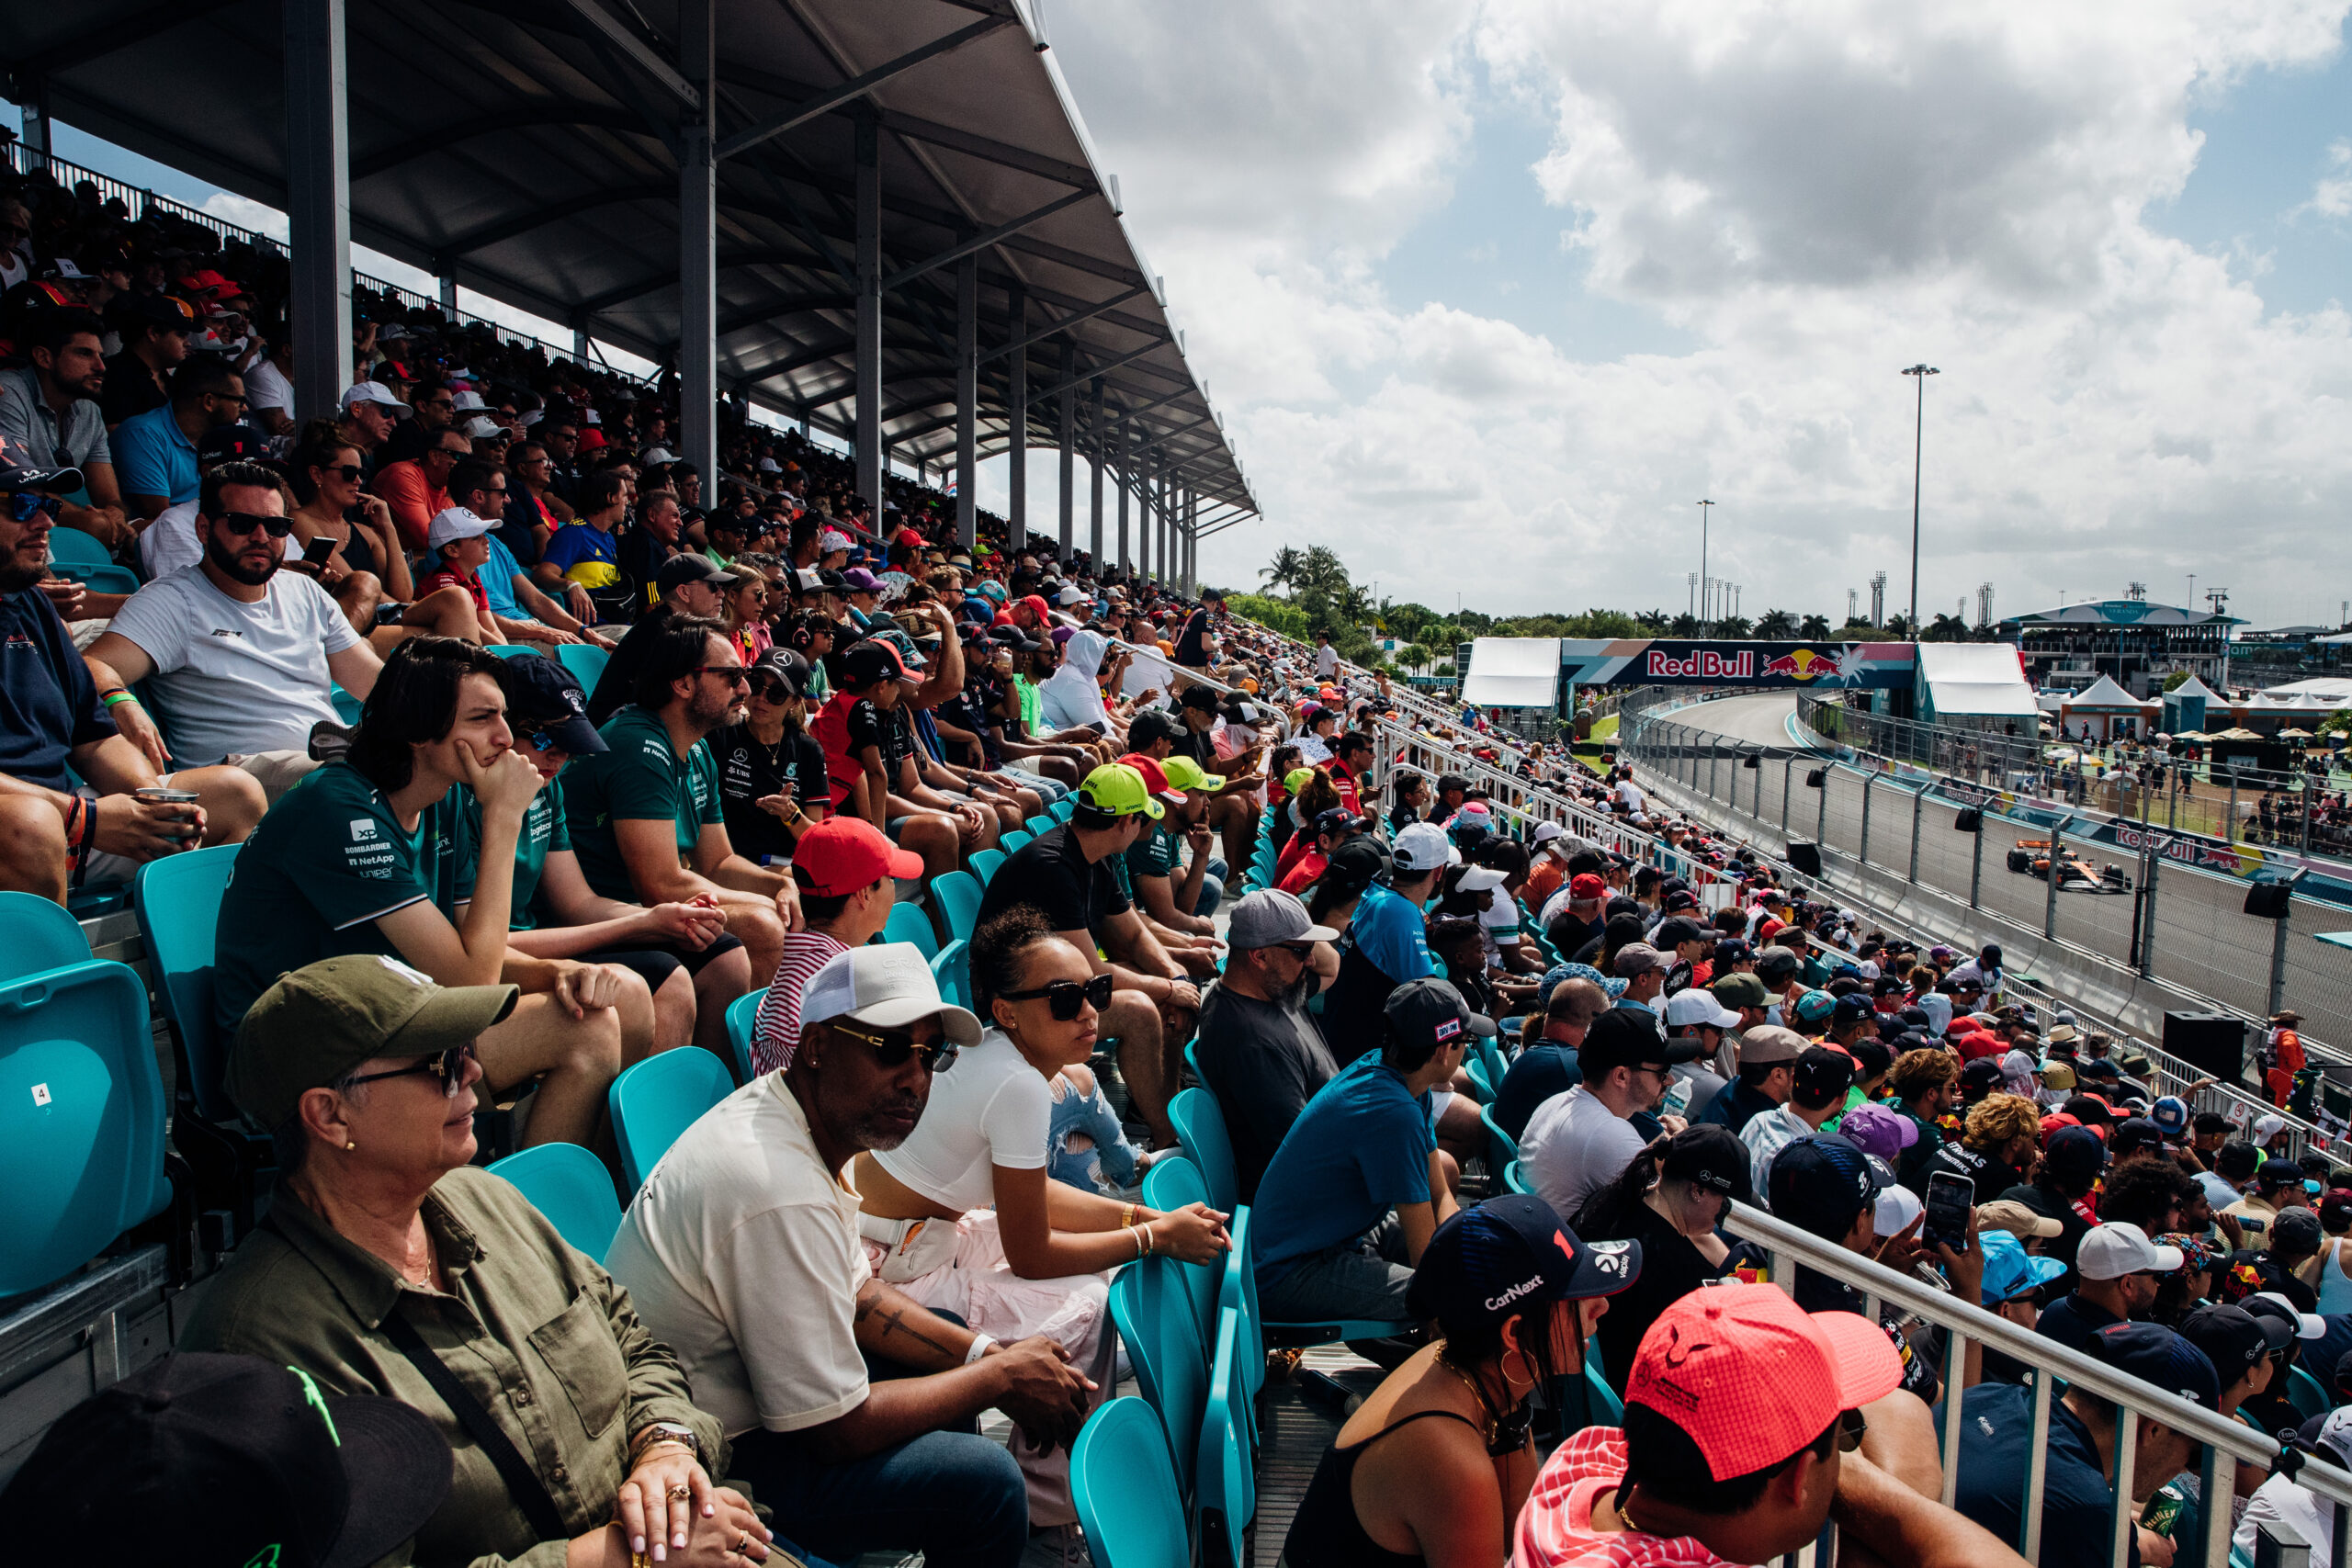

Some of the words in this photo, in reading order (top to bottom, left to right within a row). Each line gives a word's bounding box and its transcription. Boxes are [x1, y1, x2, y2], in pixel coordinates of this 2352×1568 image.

[233, 441, 243, 454] 1
[1647, 650, 1700, 677] Red
[1702, 650, 1754, 678] Bull
[736, 769, 751, 778] UBS
[1084, 779, 1098, 789] BOSS
[1125, 803, 1143, 811] aramco
[345, 842, 391, 854] BOMBARDIER
[359, 854, 395, 865] NetApp
[39, 1089, 46, 1098] 4
[1553, 1228, 1575, 1260] 1
[1618, 1254, 1631, 1279] viaplay
[1485, 1274, 1544, 1311] CarNext
[2143, 1509, 2177, 1529] HEINEK
